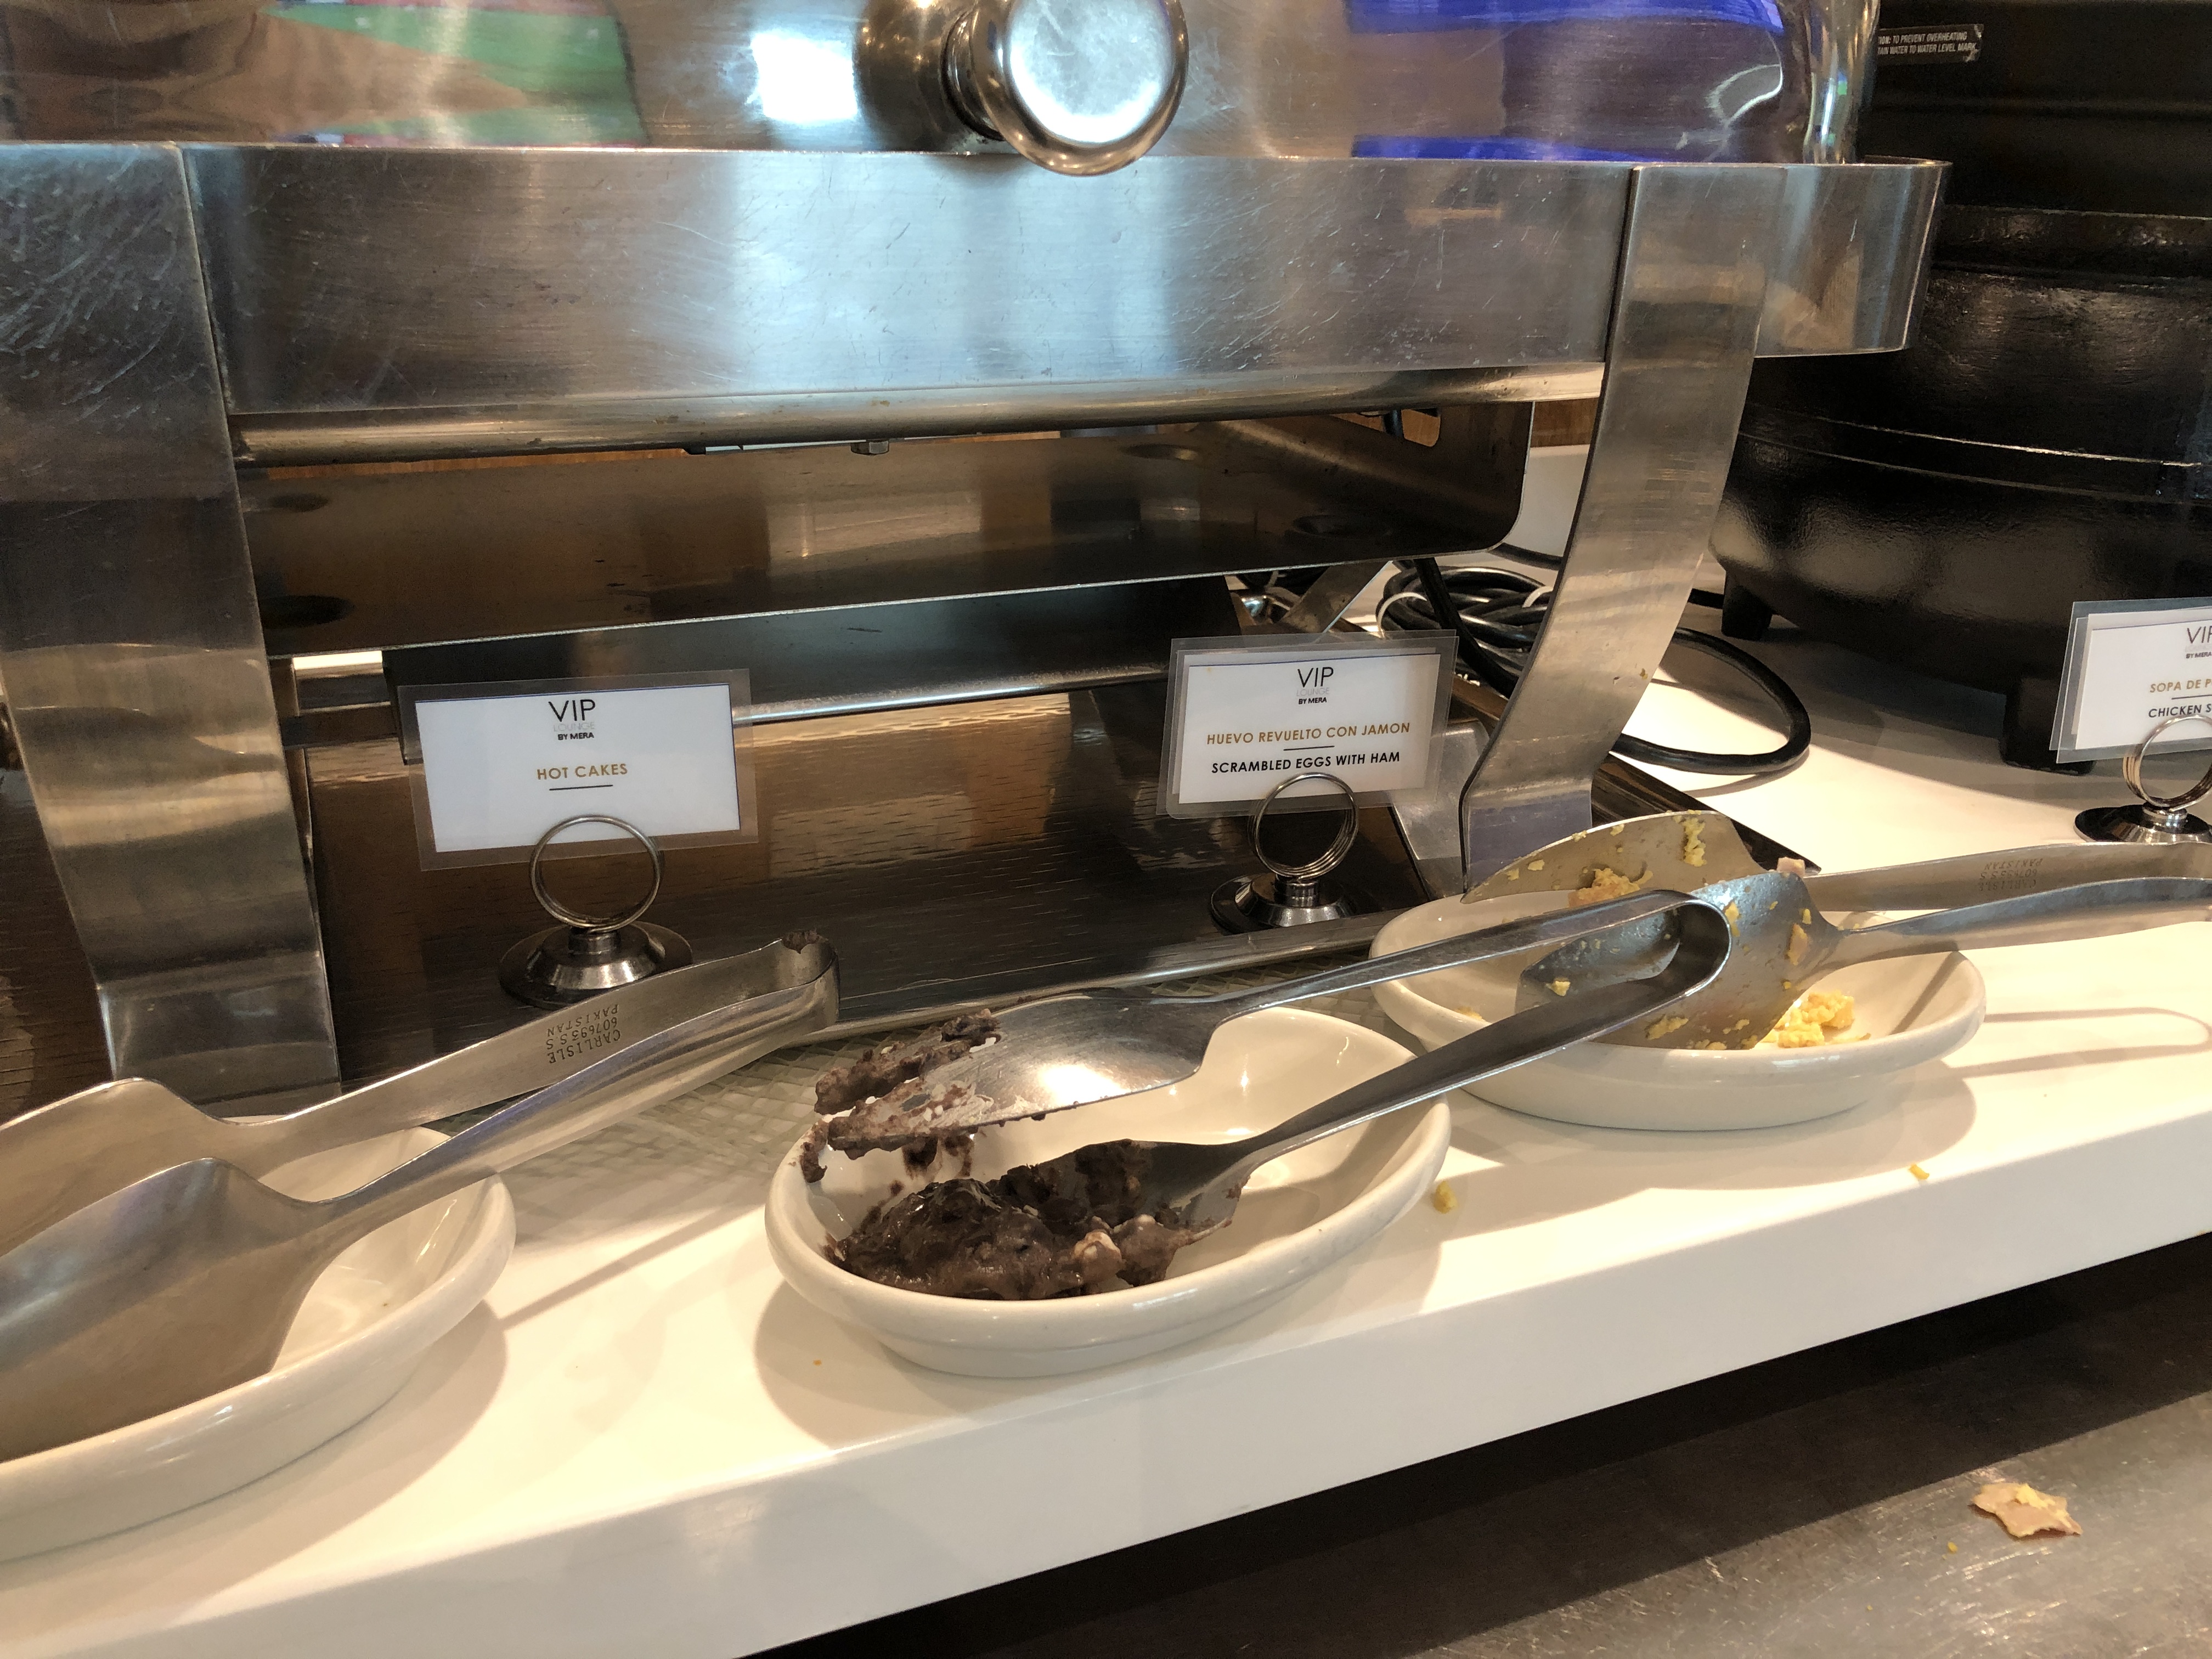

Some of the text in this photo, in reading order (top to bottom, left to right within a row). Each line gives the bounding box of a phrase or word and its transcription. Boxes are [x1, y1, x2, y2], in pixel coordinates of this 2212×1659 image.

[1893, 35, 1900, 44] TO
[1900, 34, 1926, 43] PREVENT
[1926, 31, 1967, 42] OVERHEATING
[1890, 46, 1908, 54] WATER
[1909, 45, 1917, 54] TO
[1917, 44, 1937, 53] WATER
[1938, 43, 1956, 53] LEVEL
[1297, 667, 1334, 687] VIP
[2149, 678, 2212, 693] SOPA DE P
[1296, 687, 1330, 697] LOUNGE
[548, 699, 596, 722] VIP
[2148, 703, 2212, 718] CHICKEN S
[553, 721, 596, 732] LOUNGE
[1206, 722, 1410, 745] HUEVO REVUELTO CON JAMON
[570, 731, 595, 740] MERA
[1211, 751, 1400, 774] SCRAMBLED EGGS WITH HAM
[537, 763, 628, 780] HOT CAKES
[547, 1004, 619, 1037] PAKISTAN
[572, 1017, 617, 1041] 607693
[547, 1029, 621, 1064] CARLISLE
